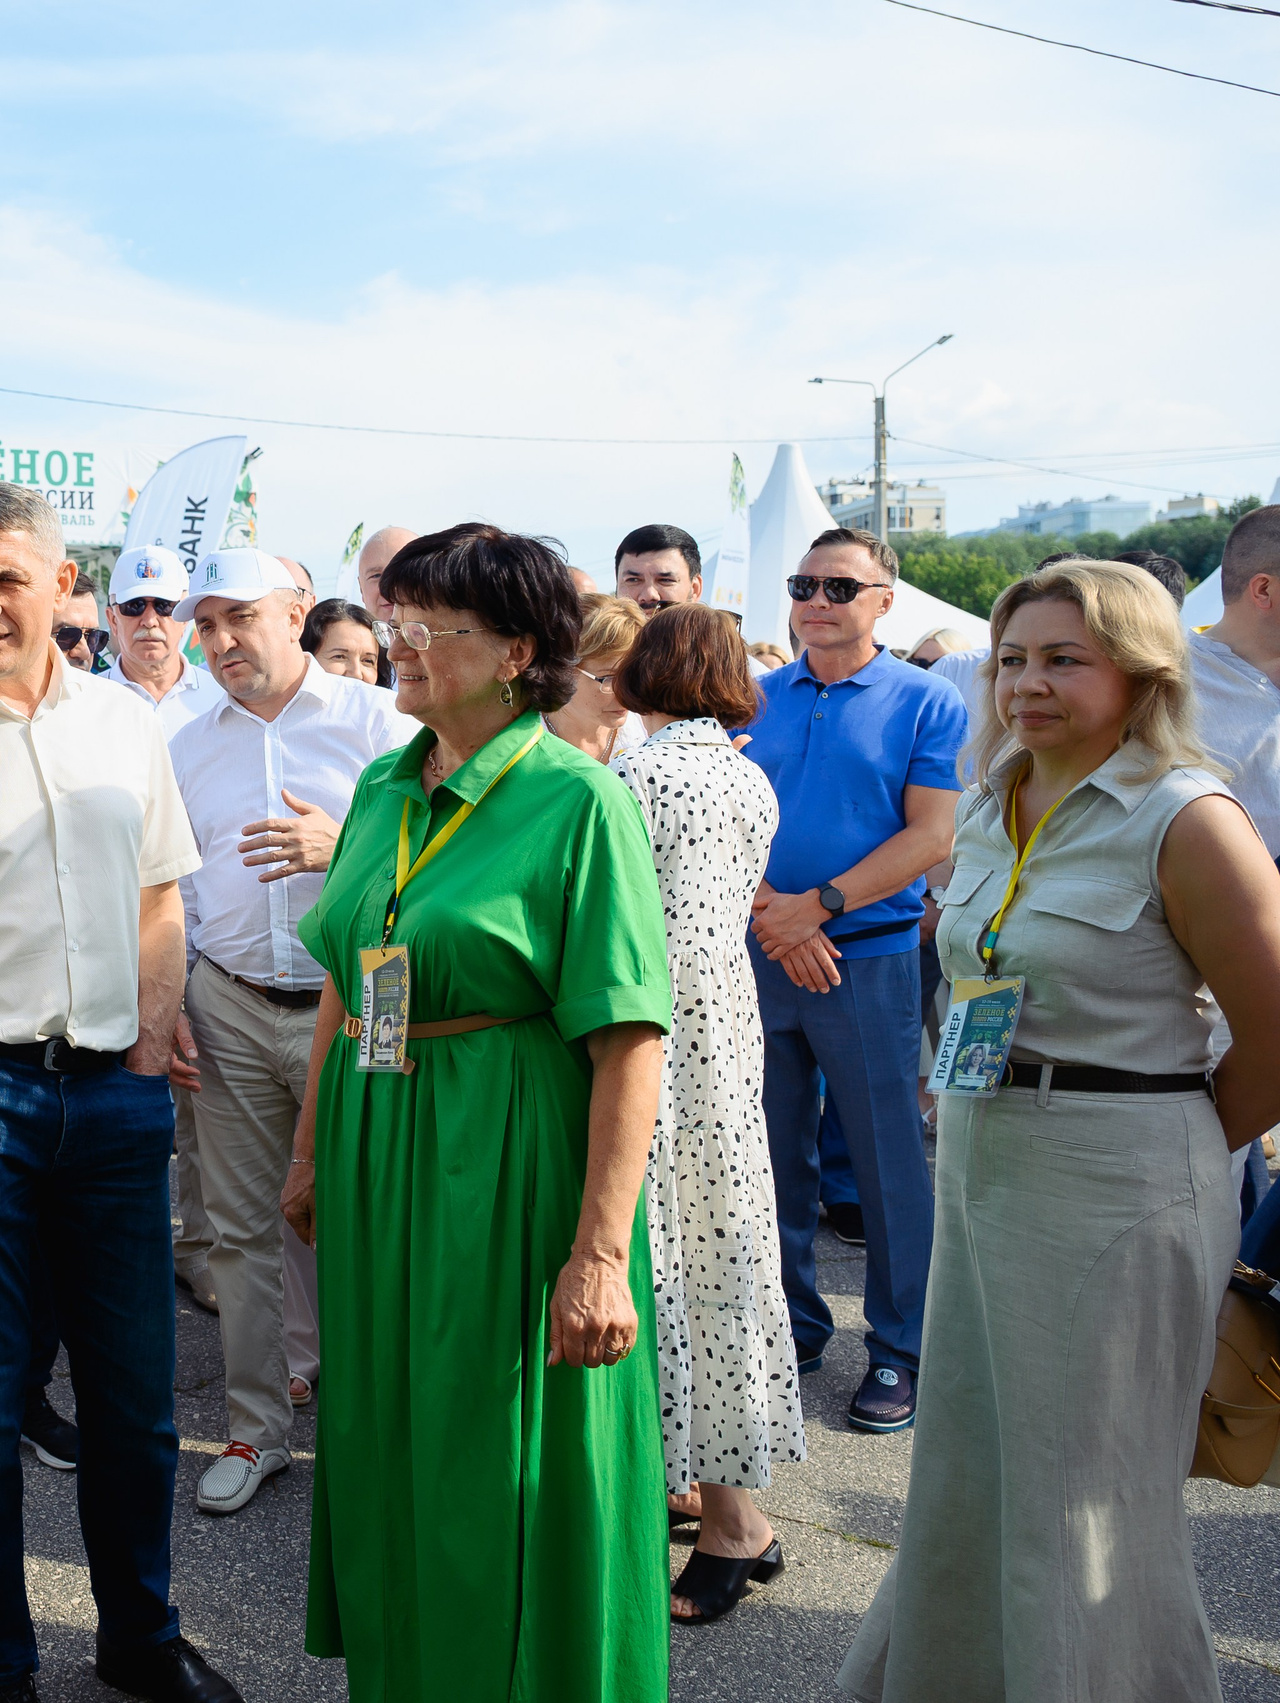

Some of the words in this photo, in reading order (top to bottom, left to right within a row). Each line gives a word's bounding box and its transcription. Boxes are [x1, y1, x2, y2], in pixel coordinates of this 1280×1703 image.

[59, 514, 95, 526] ВАЛЬ
[360, 985, 372, 1055] ПАРТНЕР
[935, 1012, 961, 1079] ПАРТНЕР
